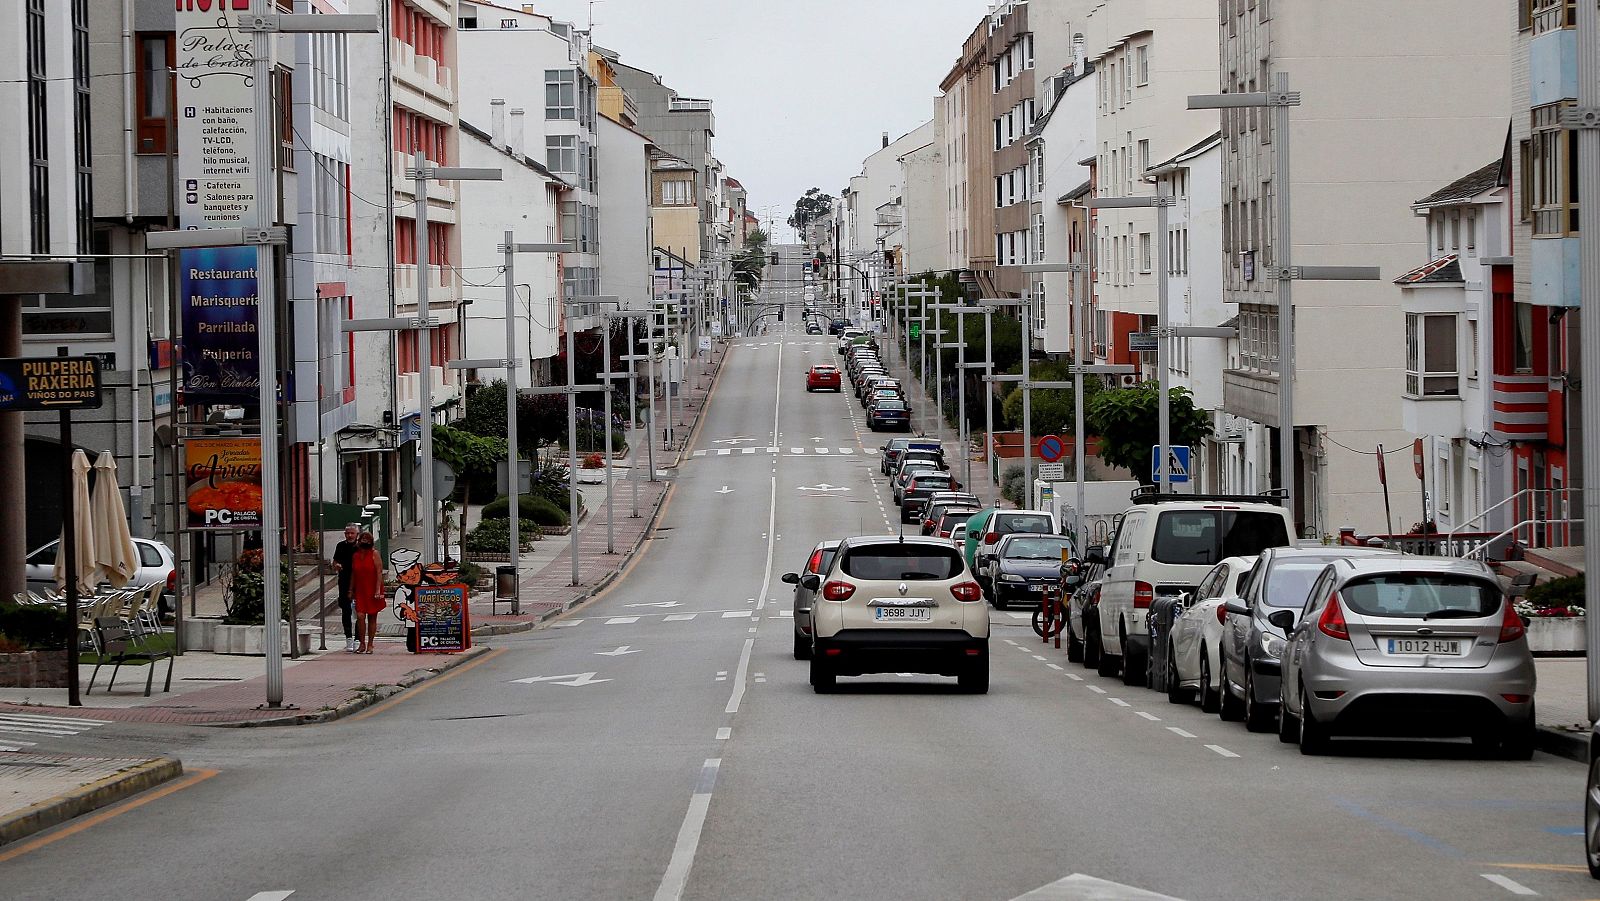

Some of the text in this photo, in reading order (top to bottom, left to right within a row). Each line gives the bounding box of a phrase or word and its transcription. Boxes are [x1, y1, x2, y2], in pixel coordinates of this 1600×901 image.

[182, 35, 252, 52] Palaci
[181, 55, 254, 68] de Crista
[202, 126, 247, 134] calefacción,
[202, 137, 234, 145] TV-LCD,
[202, 147, 236, 155] teléfono,
[219, 157, 250, 165] musical,
[235, 166, 250, 174] wifi
[204, 203, 242, 211] banquetes
[204, 213, 240, 221] reuniones
[191, 293, 261, 308] Marisquería
[198, 321, 256, 333] Parrillada
[202, 347, 252, 361] Pulpería
[22, 360, 94, 376] PULPERIA
[28, 374, 95, 391] RAXERIA
[190, 374, 216, 388] Don
[27, 390, 57, 399] VIÑOS
[74, 390, 96, 398] PAIS
[191, 454, 258, 490] Arroz
[205, 508, 232, 524] PC
[883, 608, 926, 618] 3698 JJY
[420, 636, 439, 647] PC
[1398, 640, 1458, 652] 1012 HJW
